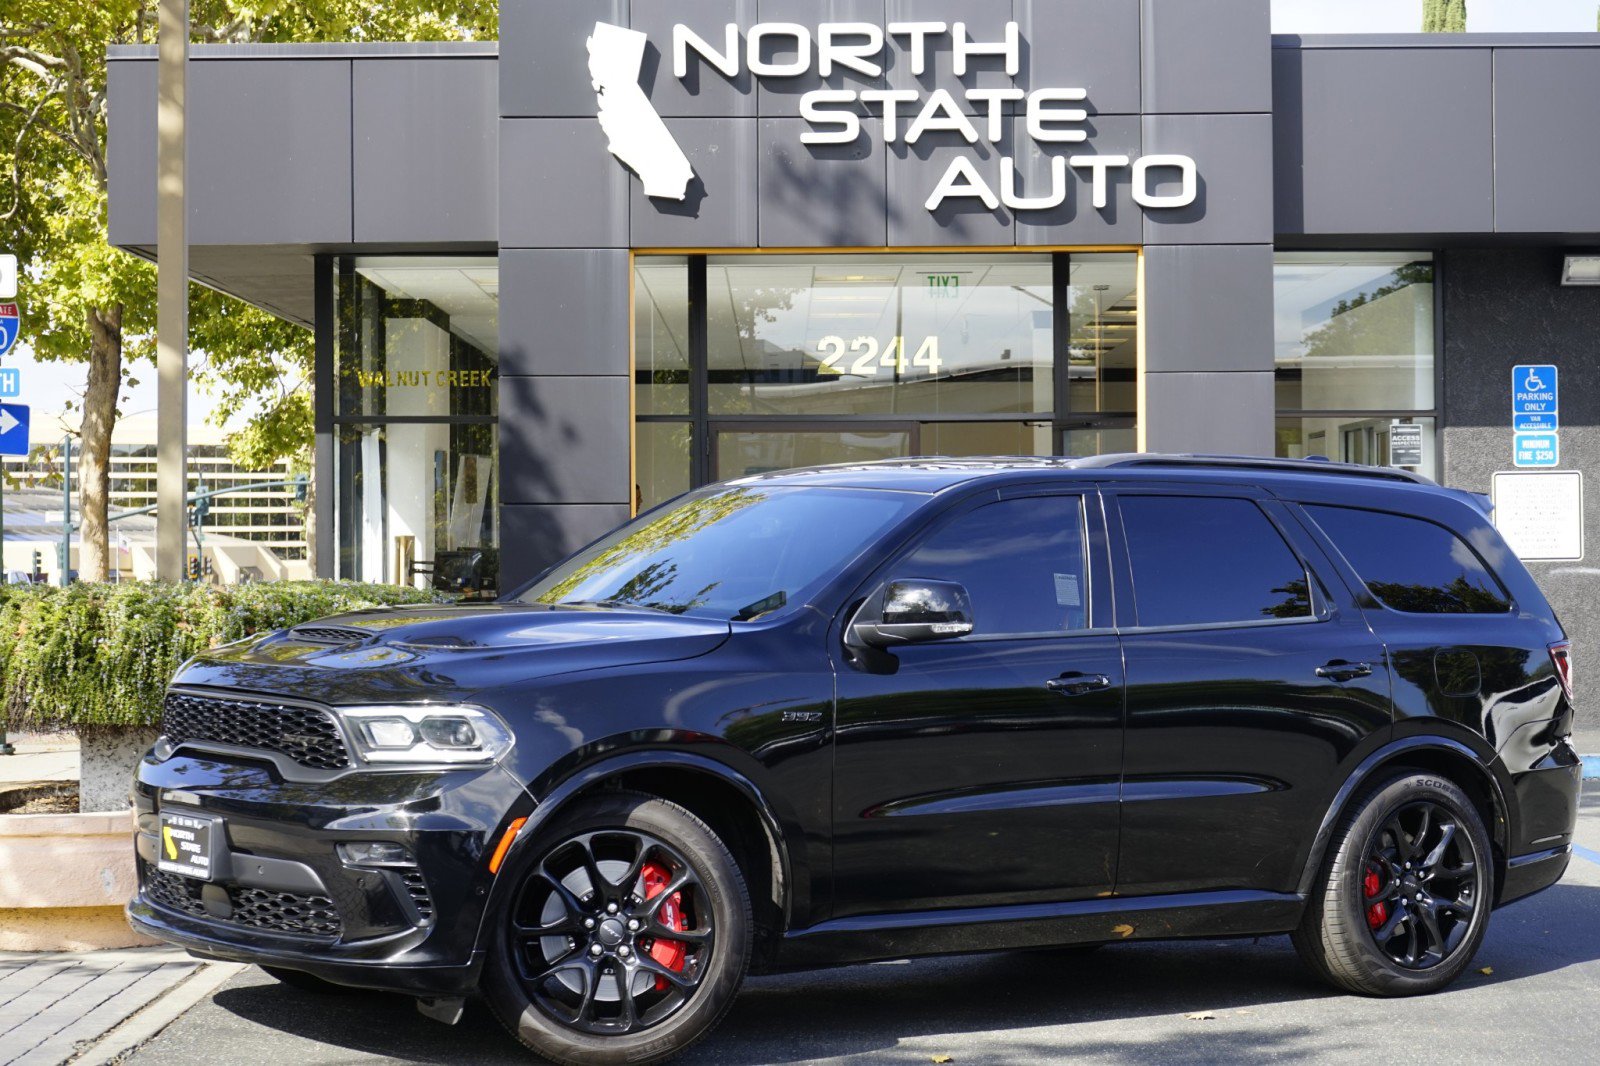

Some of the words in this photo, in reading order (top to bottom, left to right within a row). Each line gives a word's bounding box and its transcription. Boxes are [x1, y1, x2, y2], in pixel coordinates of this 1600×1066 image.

[673, 22, 1019, 77] NORTH
[799, 88, 1087, 145] STATE
[925, 155, 1197, 210] AUTO
[817, 335, 942, 375] 2244
[358, 370, 431, 388] WALNUT
[435, 368, 492, 388] CREEK
[1517, 392, 1553, 401] PARKING
[1524, 403, 1546, 411] ONLY
[1535, 450, 1554, 460] $250
